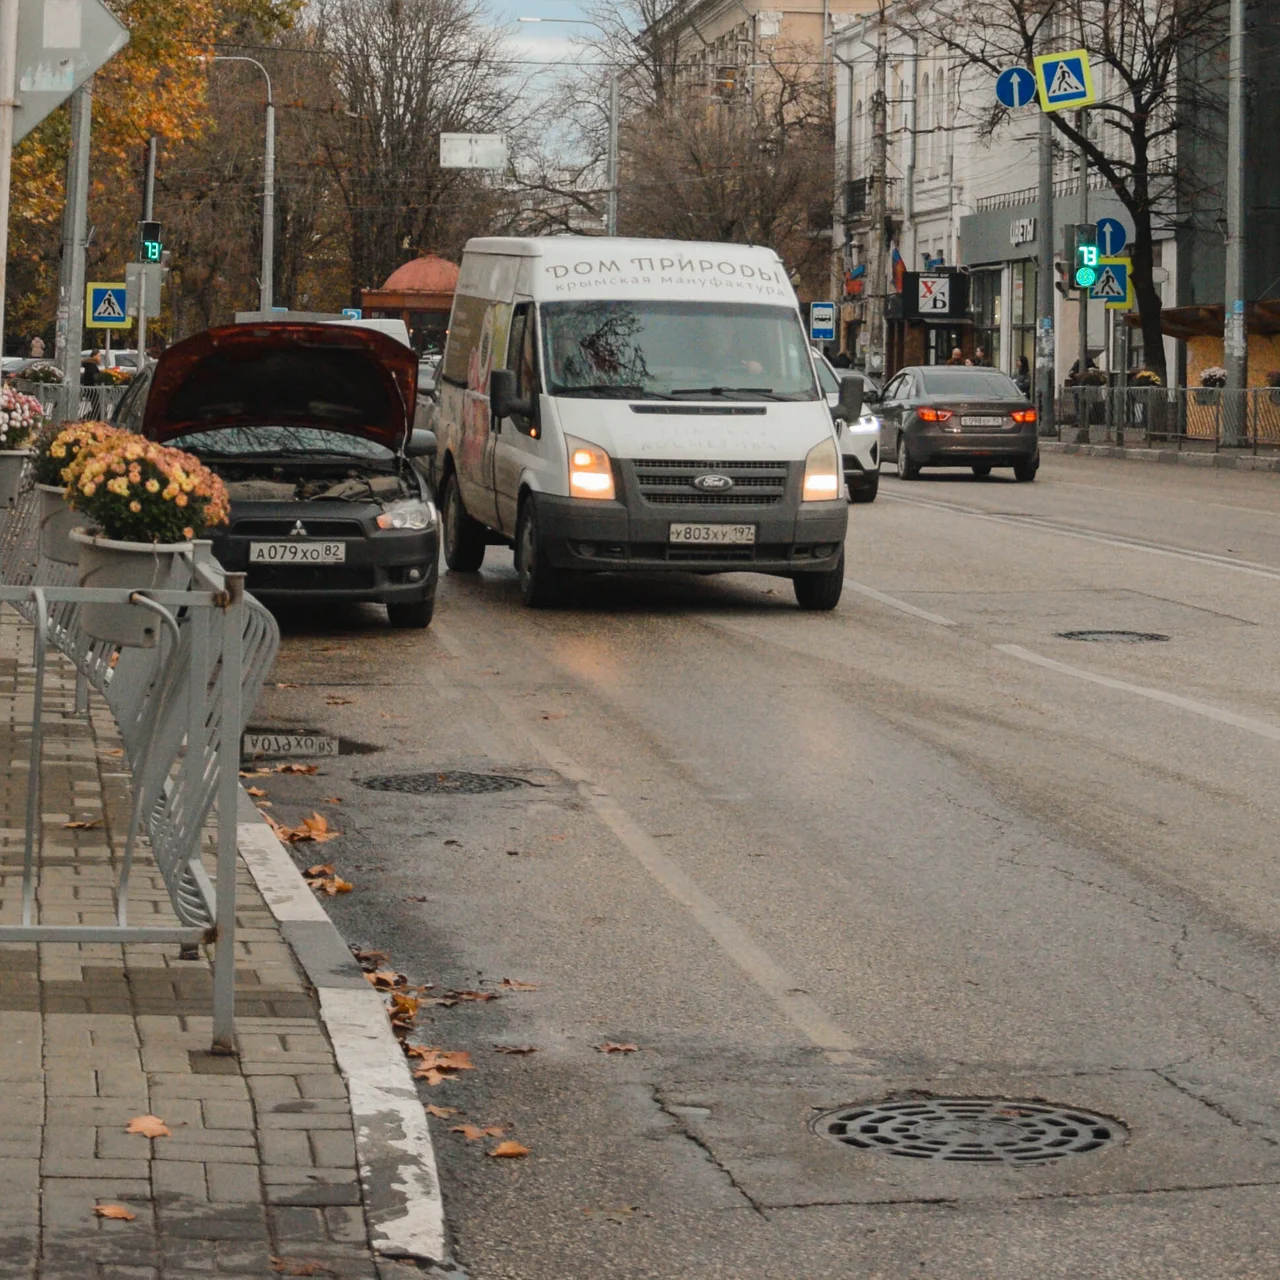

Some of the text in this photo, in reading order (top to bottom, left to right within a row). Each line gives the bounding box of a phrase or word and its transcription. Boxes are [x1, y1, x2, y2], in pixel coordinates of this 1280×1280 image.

[1009, 217, 1035, 247] ЦВЕТЫ
[144, 241, 159, 259] 73
[1078, 246, 1098, 266] 73
[545, 257, 780, 284] ДОМ ПРИРОДЫ
[555, 275, 785, 297] крымская мануфактура
[703, 476, 725, 488] Ford
[675, 527, 751, 541] У803ХУ 197
[256, 545, 340, 560] А079ХО 82
